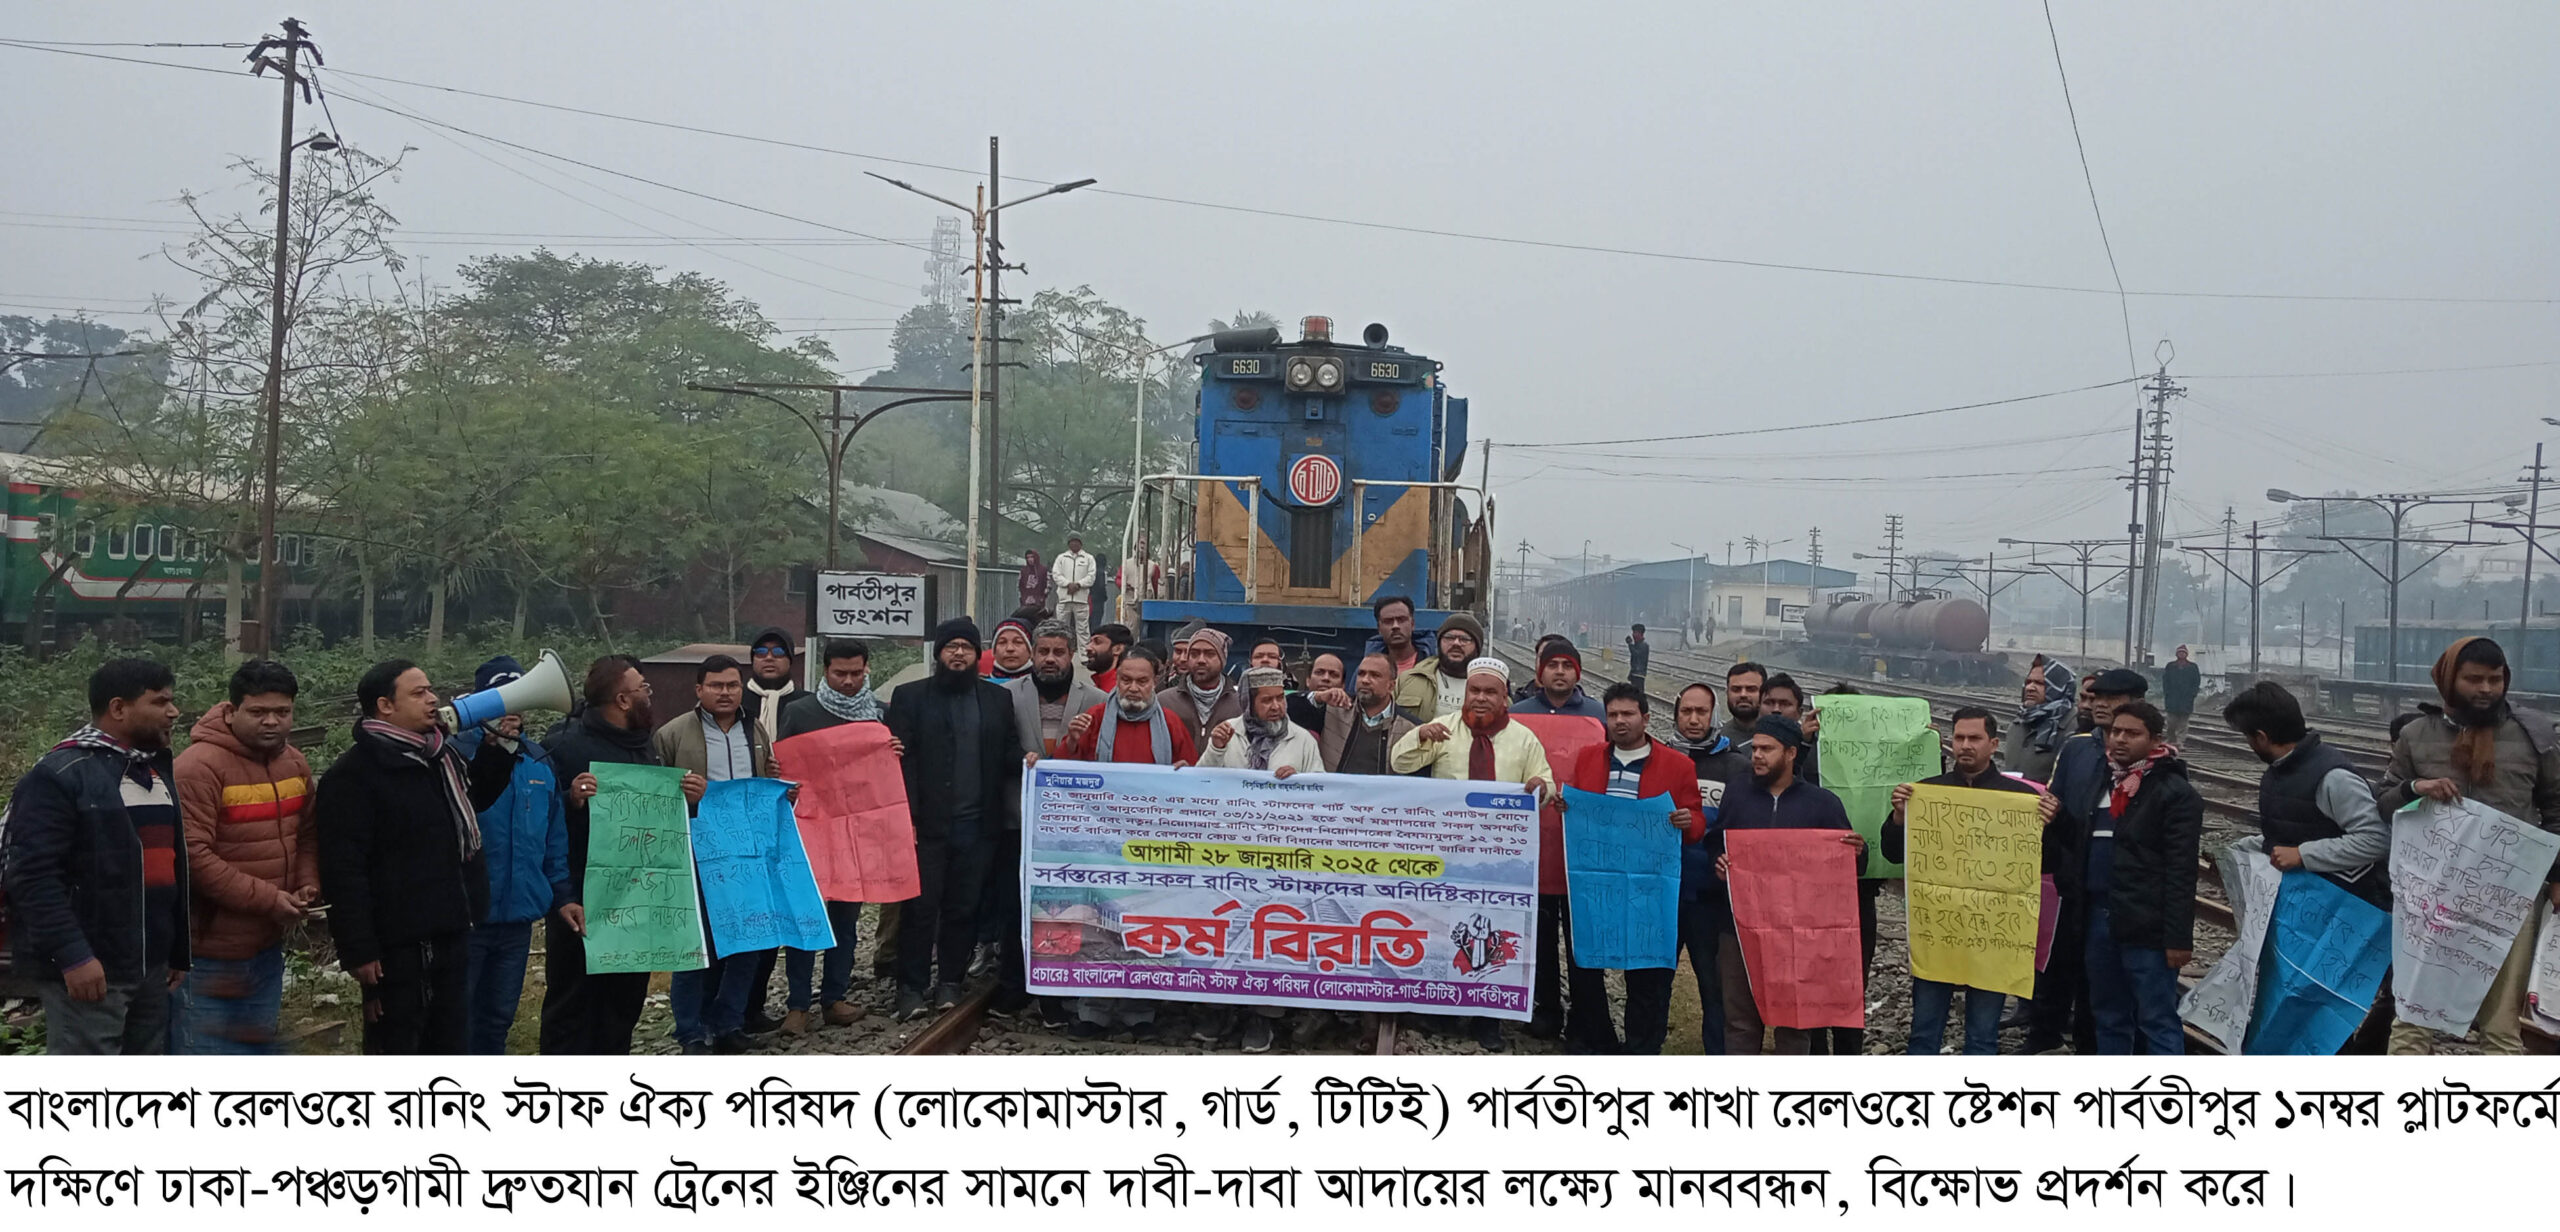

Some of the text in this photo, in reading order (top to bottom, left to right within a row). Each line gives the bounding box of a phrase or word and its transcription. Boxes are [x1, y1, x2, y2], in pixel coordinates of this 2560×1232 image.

[1232, 359, 1260, 375] 6630
[1370, 362, 1399, 379] 6630
[826, 577, 917, 607] পার্বতীপুর
[833, 608, 910, 626] জংশন
[1041, 802, 1085, 811] পেনশন
[1090, 804, 1100, 812] ও
[1178, 808, 1217, 817] প্রদানে
[1223, 810, 1304, 822] ০৩/১১/২০২১
[1311, 814, 1337, 822] হতে
[1343, 815, 1365, 825] অর্থ
[1442, 821, 1475, 831] সকল
[1042, 790, 1060, 799] ২৭
[1068, 791, 1115, 801] জানুয়ারি
[1122, 794, 1158, 803] ২০২৫
[1165, 796, 1185, 804] এর
[1190, 797, 1220, 806] মধ্যে
[1226, 797, 1257, 808] রানিং
[1262, 801, 1315, 810] স্টাফদের
[1350, 804, 1375, 813] অফ
[1381, 807, 1398, 815] পে
[1404, 807, 1436, 817] রানিং
[1490, 797, 1522, 807] এক হও
[1039, 825, 1056, 834] নং
[1058, 824, 1081, 833] শর্ত
[1085, 826, 1122, 836] বাতিল
[1126, 828, 1151, 837] করে
[1155, 830, 1202, 839] রেলওয়ে
[1207, 832, 1237, 842] কোড
[1242, 834, 1251, 842] ও
[1337, 839, 1390, 849] আলোকে
[1393, 841, 1434, 852] আদেশ
[1438, 843, 1476, 854] জারির
[1096, 816, 1121, 825] এবং
[1125, 818, 1153, 827] নতুন
[1226, 821, 1257, 832] রানিং
[1470, 835, 1487, 844] ১২
[1493, 836, 1504, 844] ও
[1510, 837, 1528, 845] ১৩
[1128, 841, 1440, 877] আগামী ২৮ জানুয়ারি ২০২৫ থেকে
[1033, 863, 1534, 908] সর্বস্তরের সকল রানিং স্টাফদের অনির্দিষ্টকালের
[1121, 899, 1428, 973] কর্ম বিরতি
[1032, 967, 1069, 985] প্রচারেঃ
[1073, 968, 1125, 985] বাংলাদেশ
[1129, 971, 1174, 987] রেলওয়ে
[1178, 969, 1206, 989] রানিং
[1210, 971, 1239, 990] স্টাফ
[1242, 970, 1269, 992] ঐক্য
[1272, 974, 1310, 995] পরিষদ
